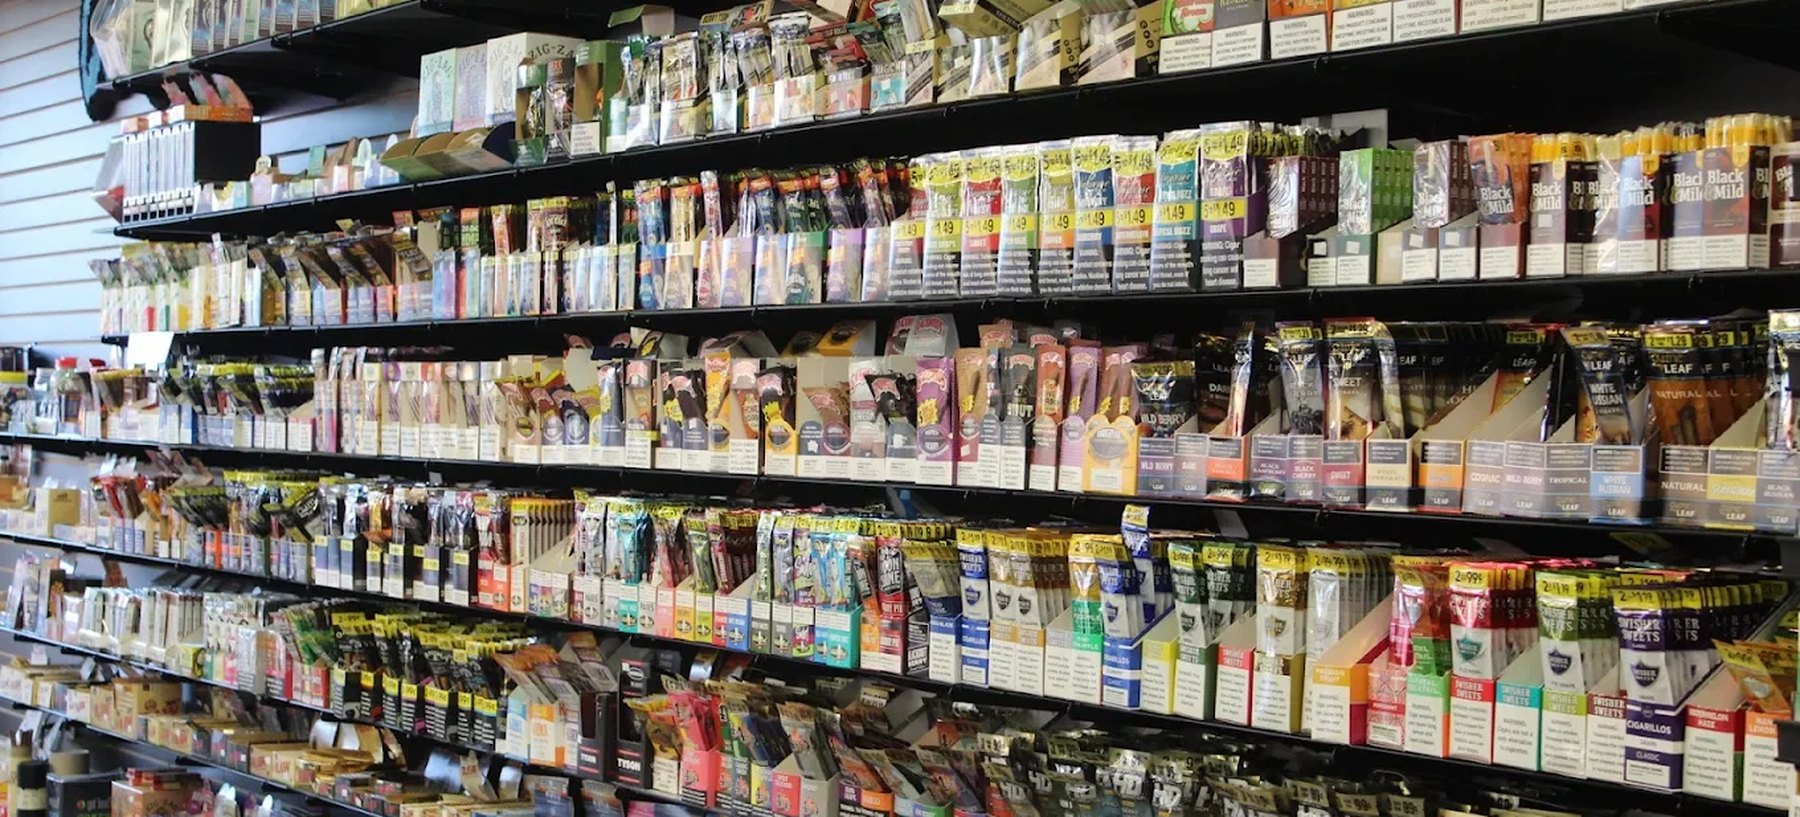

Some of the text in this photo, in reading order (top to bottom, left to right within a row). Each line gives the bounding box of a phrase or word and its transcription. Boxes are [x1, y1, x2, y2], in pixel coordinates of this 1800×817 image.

[1708, 169, 1744, 184] Black
[1481, 186, 1512, 201] Black
[1532, 182, 1562, 196] Black
[1714, 184, 1744, 199] Mild
[1488, 200, 1514, 214] Mild
[1536, 196, 1562, 210] Mild
[1400, 356, 1416, 364] EAF
[1591, 360, 1612, 370] LEAF
[1212, 363, 1230, 372] LEA
[1664, 364, 1693, 374] LEAF
[1589, 384, 1616, 394] WHITE
[1656, 390, 1702, 398] NATURAL
[1158, 412, 1186, 425] BERRY
[1292, 472, 1316, 480] CHERRY
[1472, 472, 1500, 484] COGNAC
[1603, 476, 1626, 484] WHITE
[1598, 484, 1632, 494] RUSSIAN
[1662, 482, 1706, 492] NATURAL
[1768, 484, 1790, 492] BLACK
[1608, 508, 1626, 516] LEAF
[1726, 512, 1746, 520] LEAF
[1772, 516, 1789, 524] LEAF
[1456, 570, 1482, 583] 2 99¢
[1543, 581, 1548, 592] 2
[1620, 591, 1627, 602] 2
[1618, 617, 1660, 630] SWISHER
[1622, 630, 1660, 642] SWEETS
[1593, 698, 1624, 708] SWISHER
[1594, 708, 1624, 718] SWEETS
[1627, 720, 1672, 734] CIGARILLOS
[580, 752, 596, 764] TYSON
[1636, 751, 1660, 762] CLASSIC
[618, 758, 641, 772] TYSON
